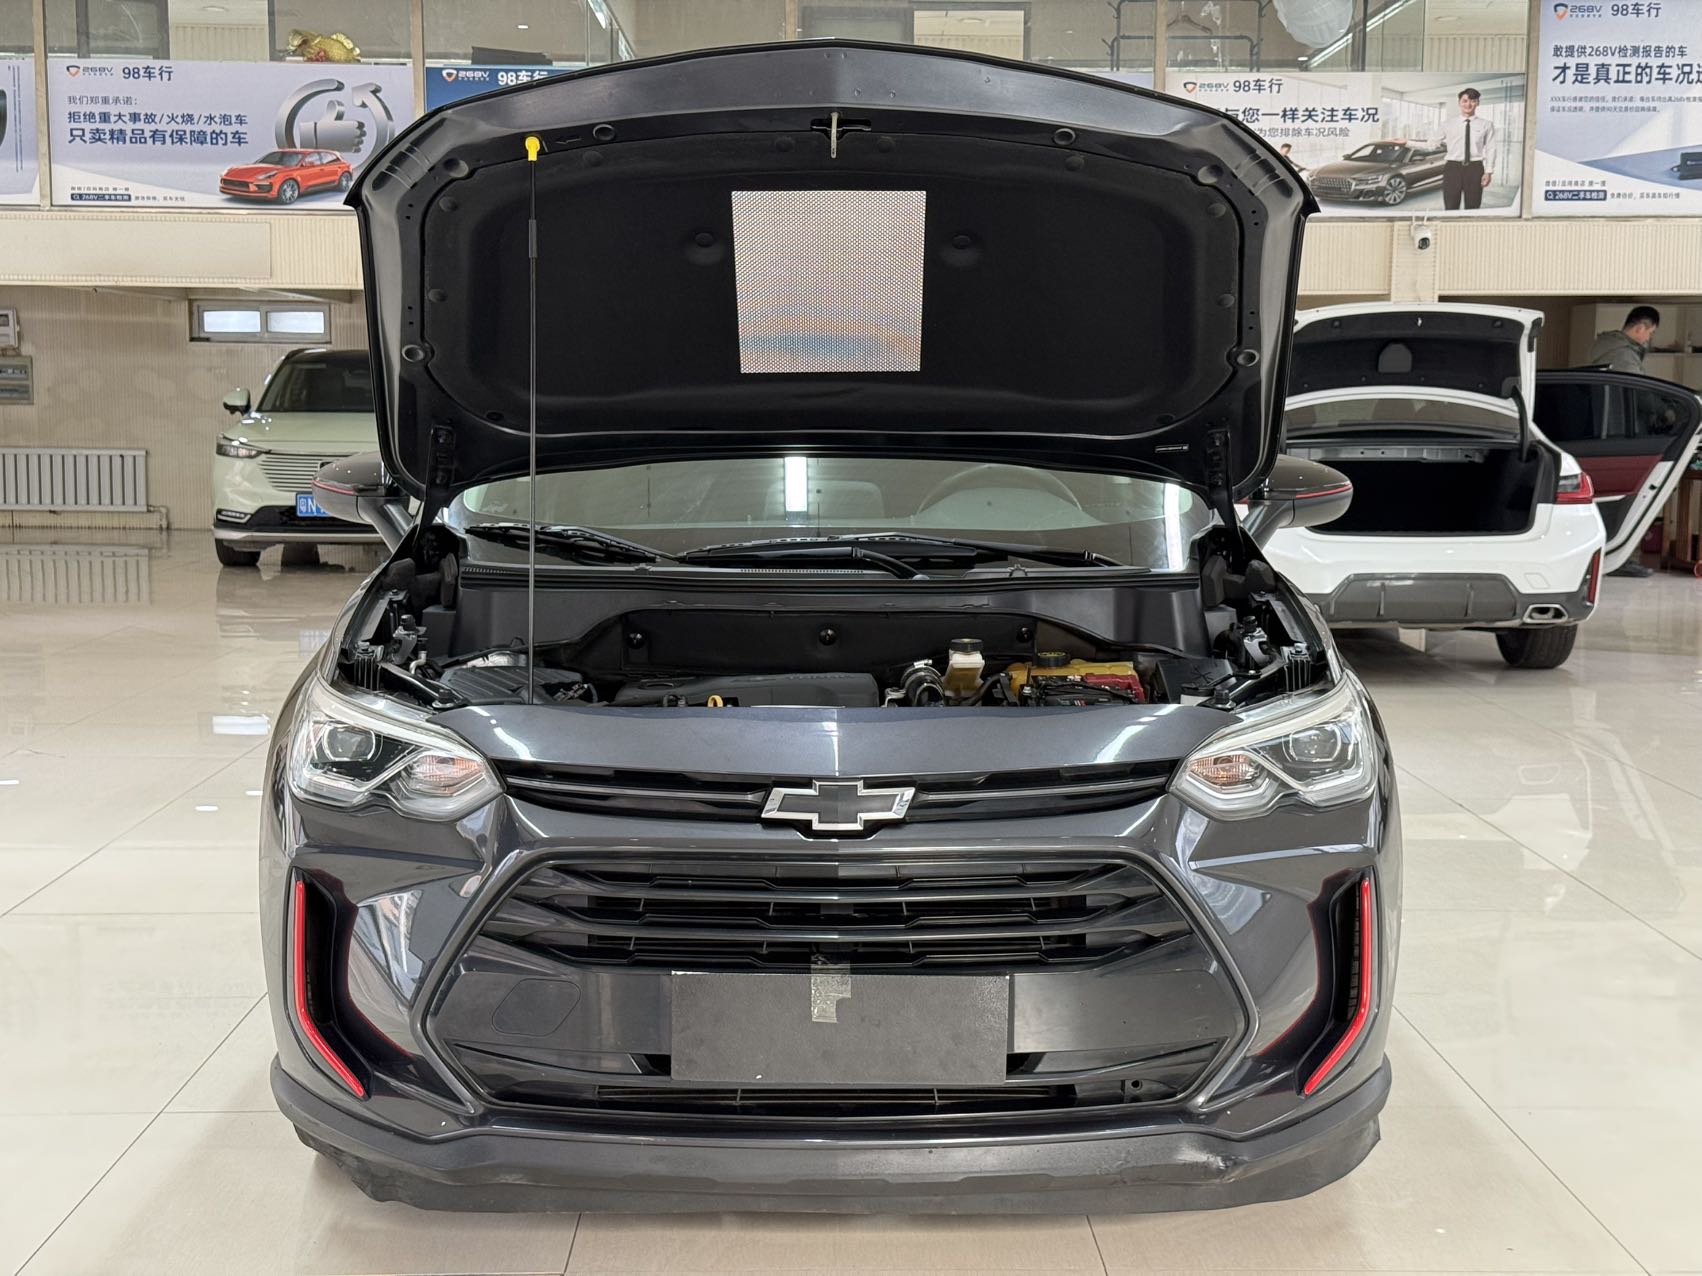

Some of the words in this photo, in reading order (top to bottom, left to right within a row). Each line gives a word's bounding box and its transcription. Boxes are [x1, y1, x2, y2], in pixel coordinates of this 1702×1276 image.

[1570, 5, 1602, 13] 268V
[1611, 2, 1662, 17] 98车行
[1553, 44, 1688, 58] 敢提供268V检测报告的车
[122, 65, 173, 81] 98车行
[1233, 78, 1283, 93] 98车行
[67, 111, 248, 126] 拒绝重大事故/火烧/水泡车
[68, 128, 248, 146] 只卖精品有保障的车
